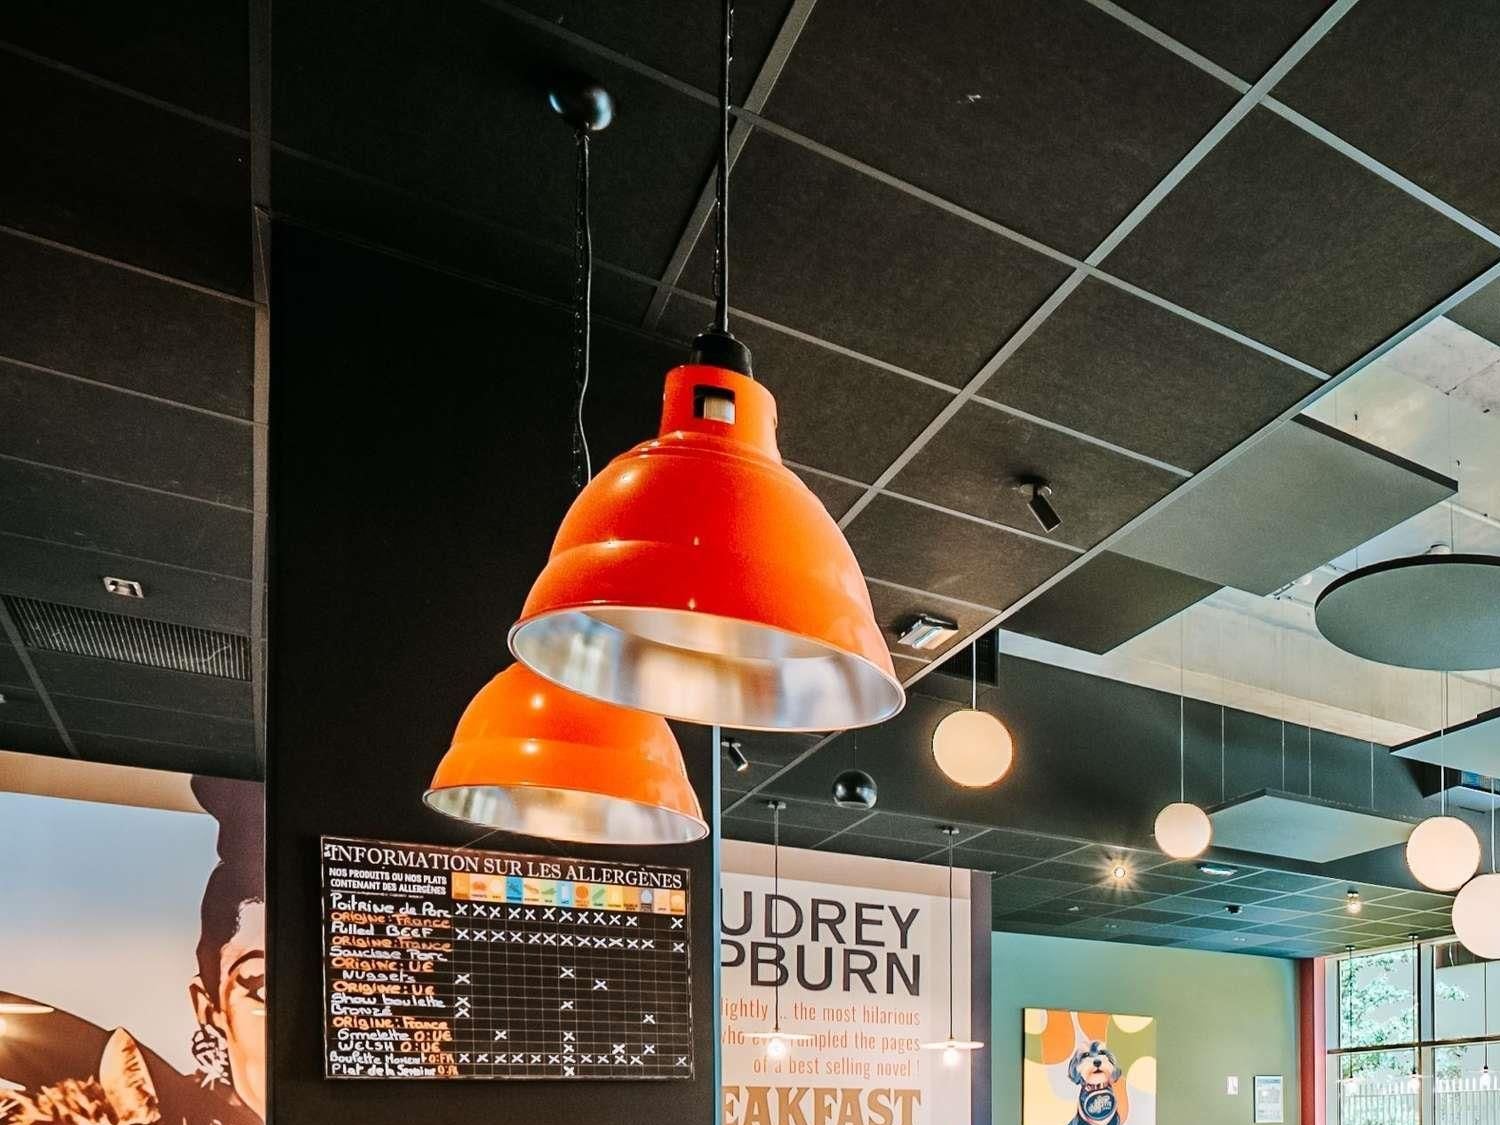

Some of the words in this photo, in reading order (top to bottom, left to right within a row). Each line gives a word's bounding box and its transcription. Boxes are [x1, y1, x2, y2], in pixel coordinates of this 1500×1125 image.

[328, 844, 481, 873] INFORMATION
[484, 857, 523, 877] SUR
[527, 861, 562, 879] LES
[566, 865, 682, 889] ALLERGÈNES
[329, 867, 348, 878] NOS
[349, 869, 390, 881] PRODUITS
[392, 872, 402, 882] OU
[405, 873, 422, 883] NOS
[423, 874, 447, 886] PLATS
[330, 879, 380, 891] CONTENANT
[382, 882, 397, 892] DES
[399, 882, 446, 896] ALLERGÈNES
[399, 902, 417, 915] de
[793, 1002, 816, 1021] the
[822, 1004, 856, 1023] most
[863, 1006, 920, 1026] hilarious
[854, 1031, 876, 1049] the
[881, 1036, 921, 1054] pages
[788, 1057, 819, 1075] best
[826, 1058, 871, 1080] selling
